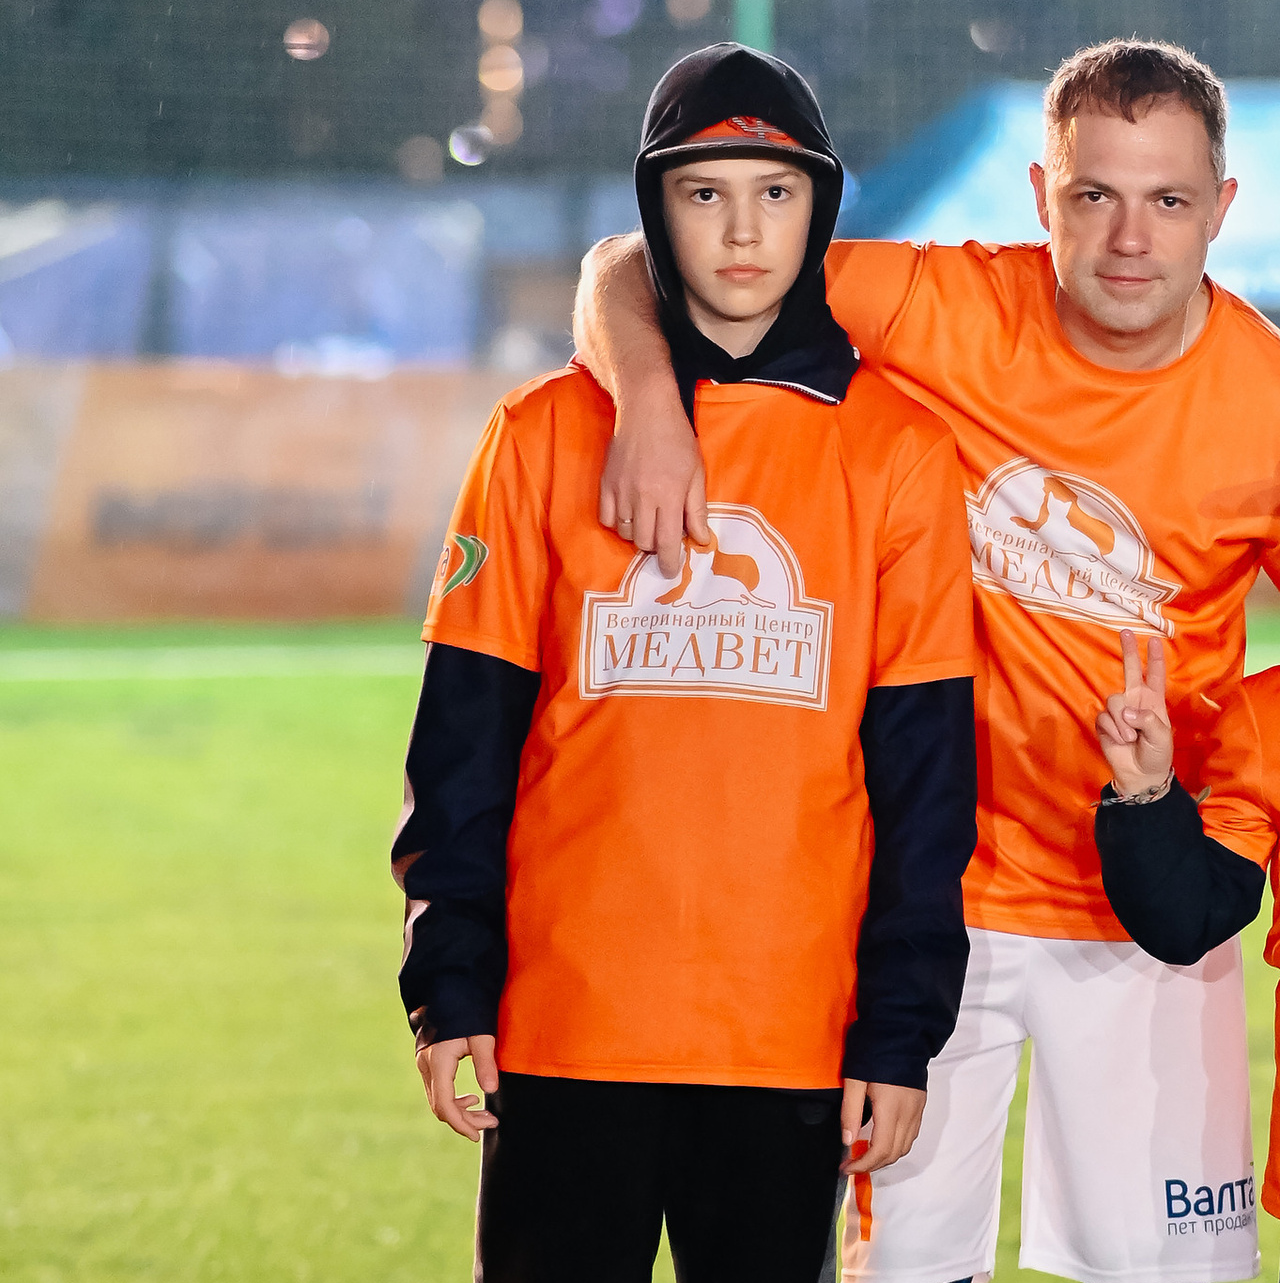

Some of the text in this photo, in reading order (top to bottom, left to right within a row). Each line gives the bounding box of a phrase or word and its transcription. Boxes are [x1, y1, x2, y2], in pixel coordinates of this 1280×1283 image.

[606, 611, 814, 639] Ветеринарный Центр
[602, 631, 812, 679] МЕДВЕТ
[1167, 1220, 1198, 1236] пет
